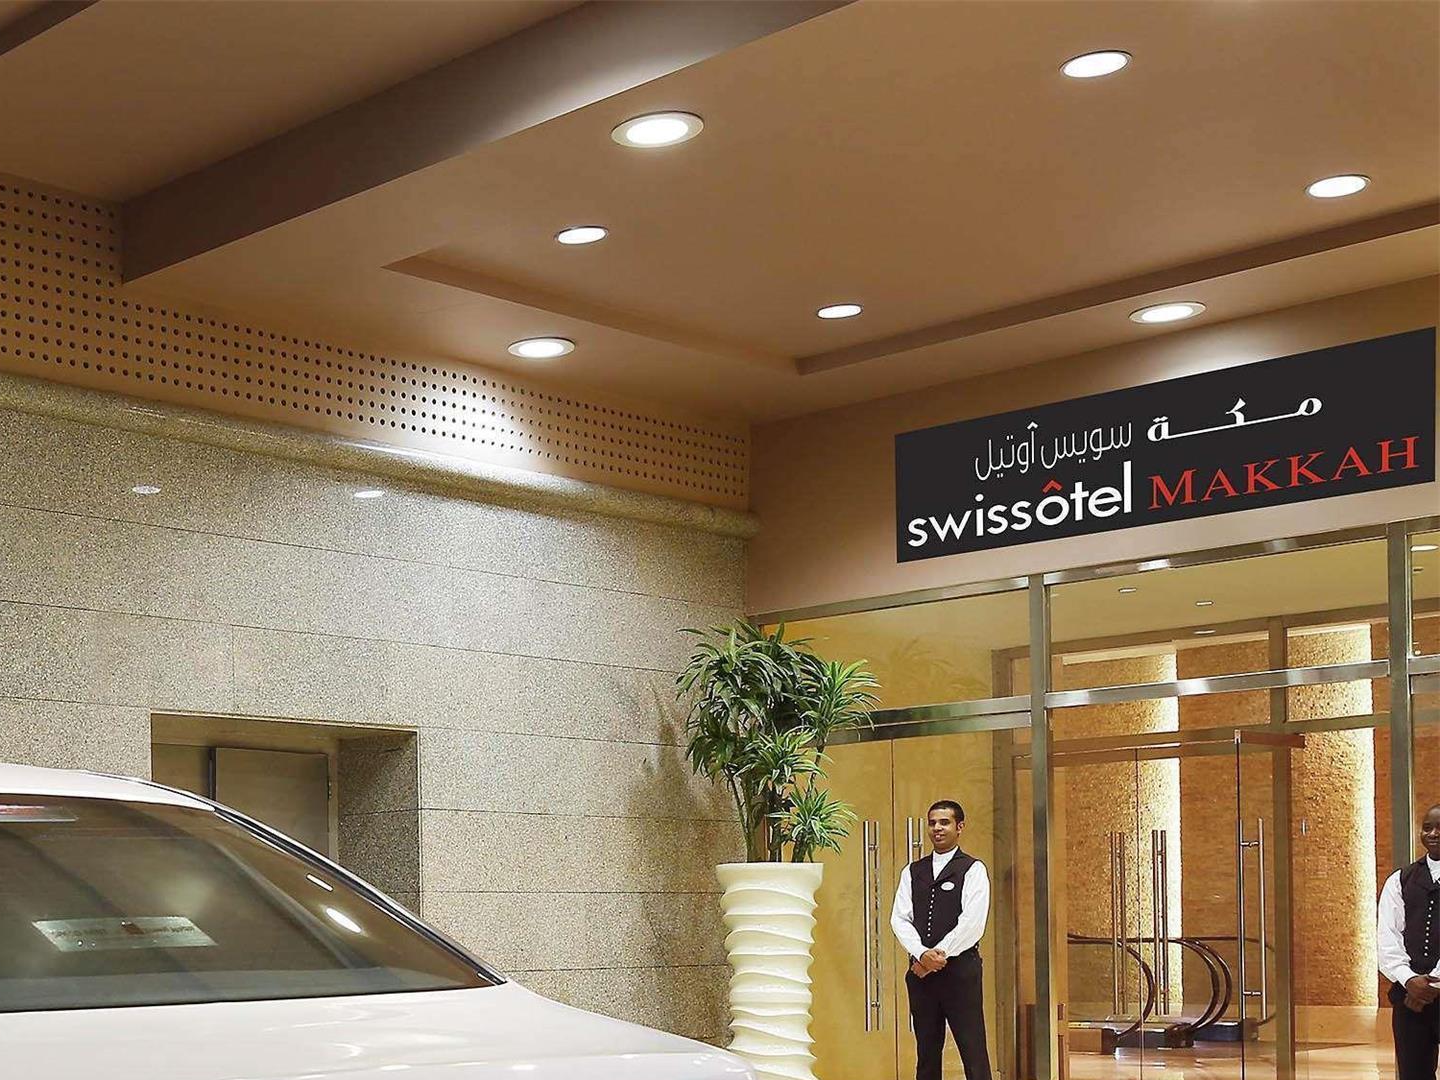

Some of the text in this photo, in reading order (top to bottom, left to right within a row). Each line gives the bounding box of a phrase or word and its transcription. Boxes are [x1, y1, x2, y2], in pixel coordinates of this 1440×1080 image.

[1040, 421, 1133, 470] سويس
[907, 436, 1419, 548] swissôtel MAKKAH
